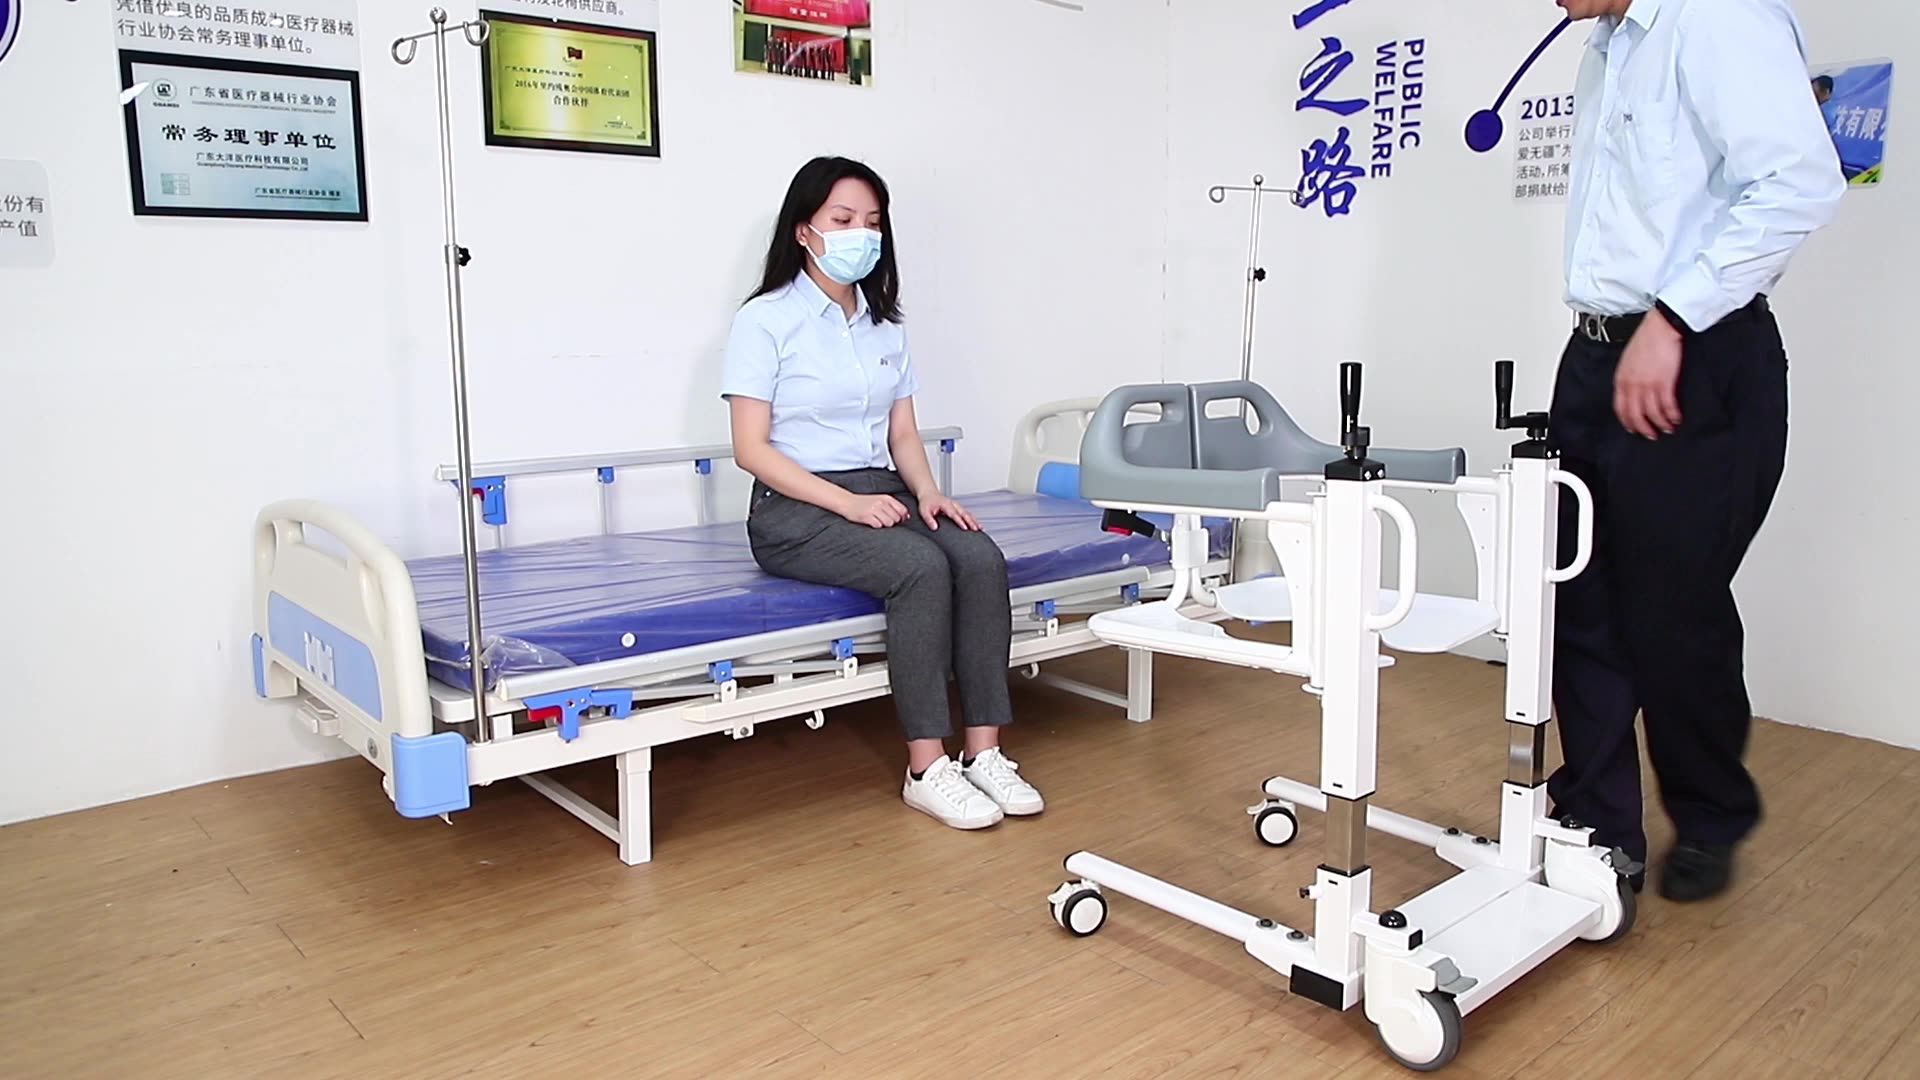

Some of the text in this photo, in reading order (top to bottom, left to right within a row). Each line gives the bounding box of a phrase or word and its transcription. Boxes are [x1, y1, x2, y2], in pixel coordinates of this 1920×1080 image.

[117, 18, 313, 55] 行业协会常务理事单位。
[189, 85, 337, 107] 广东省医疗器械行业协会
[1400, 38, 1425, 150] PUBLIC
[1371, 40, 1398, 179] WELFARE
[1521, 95, 1574, 120] 2013
[162, 124, 336, 150] 常务理事单位
[1515, 182, 1569, 198] 部捐献给
[0, 194, 44, 214] 份有
